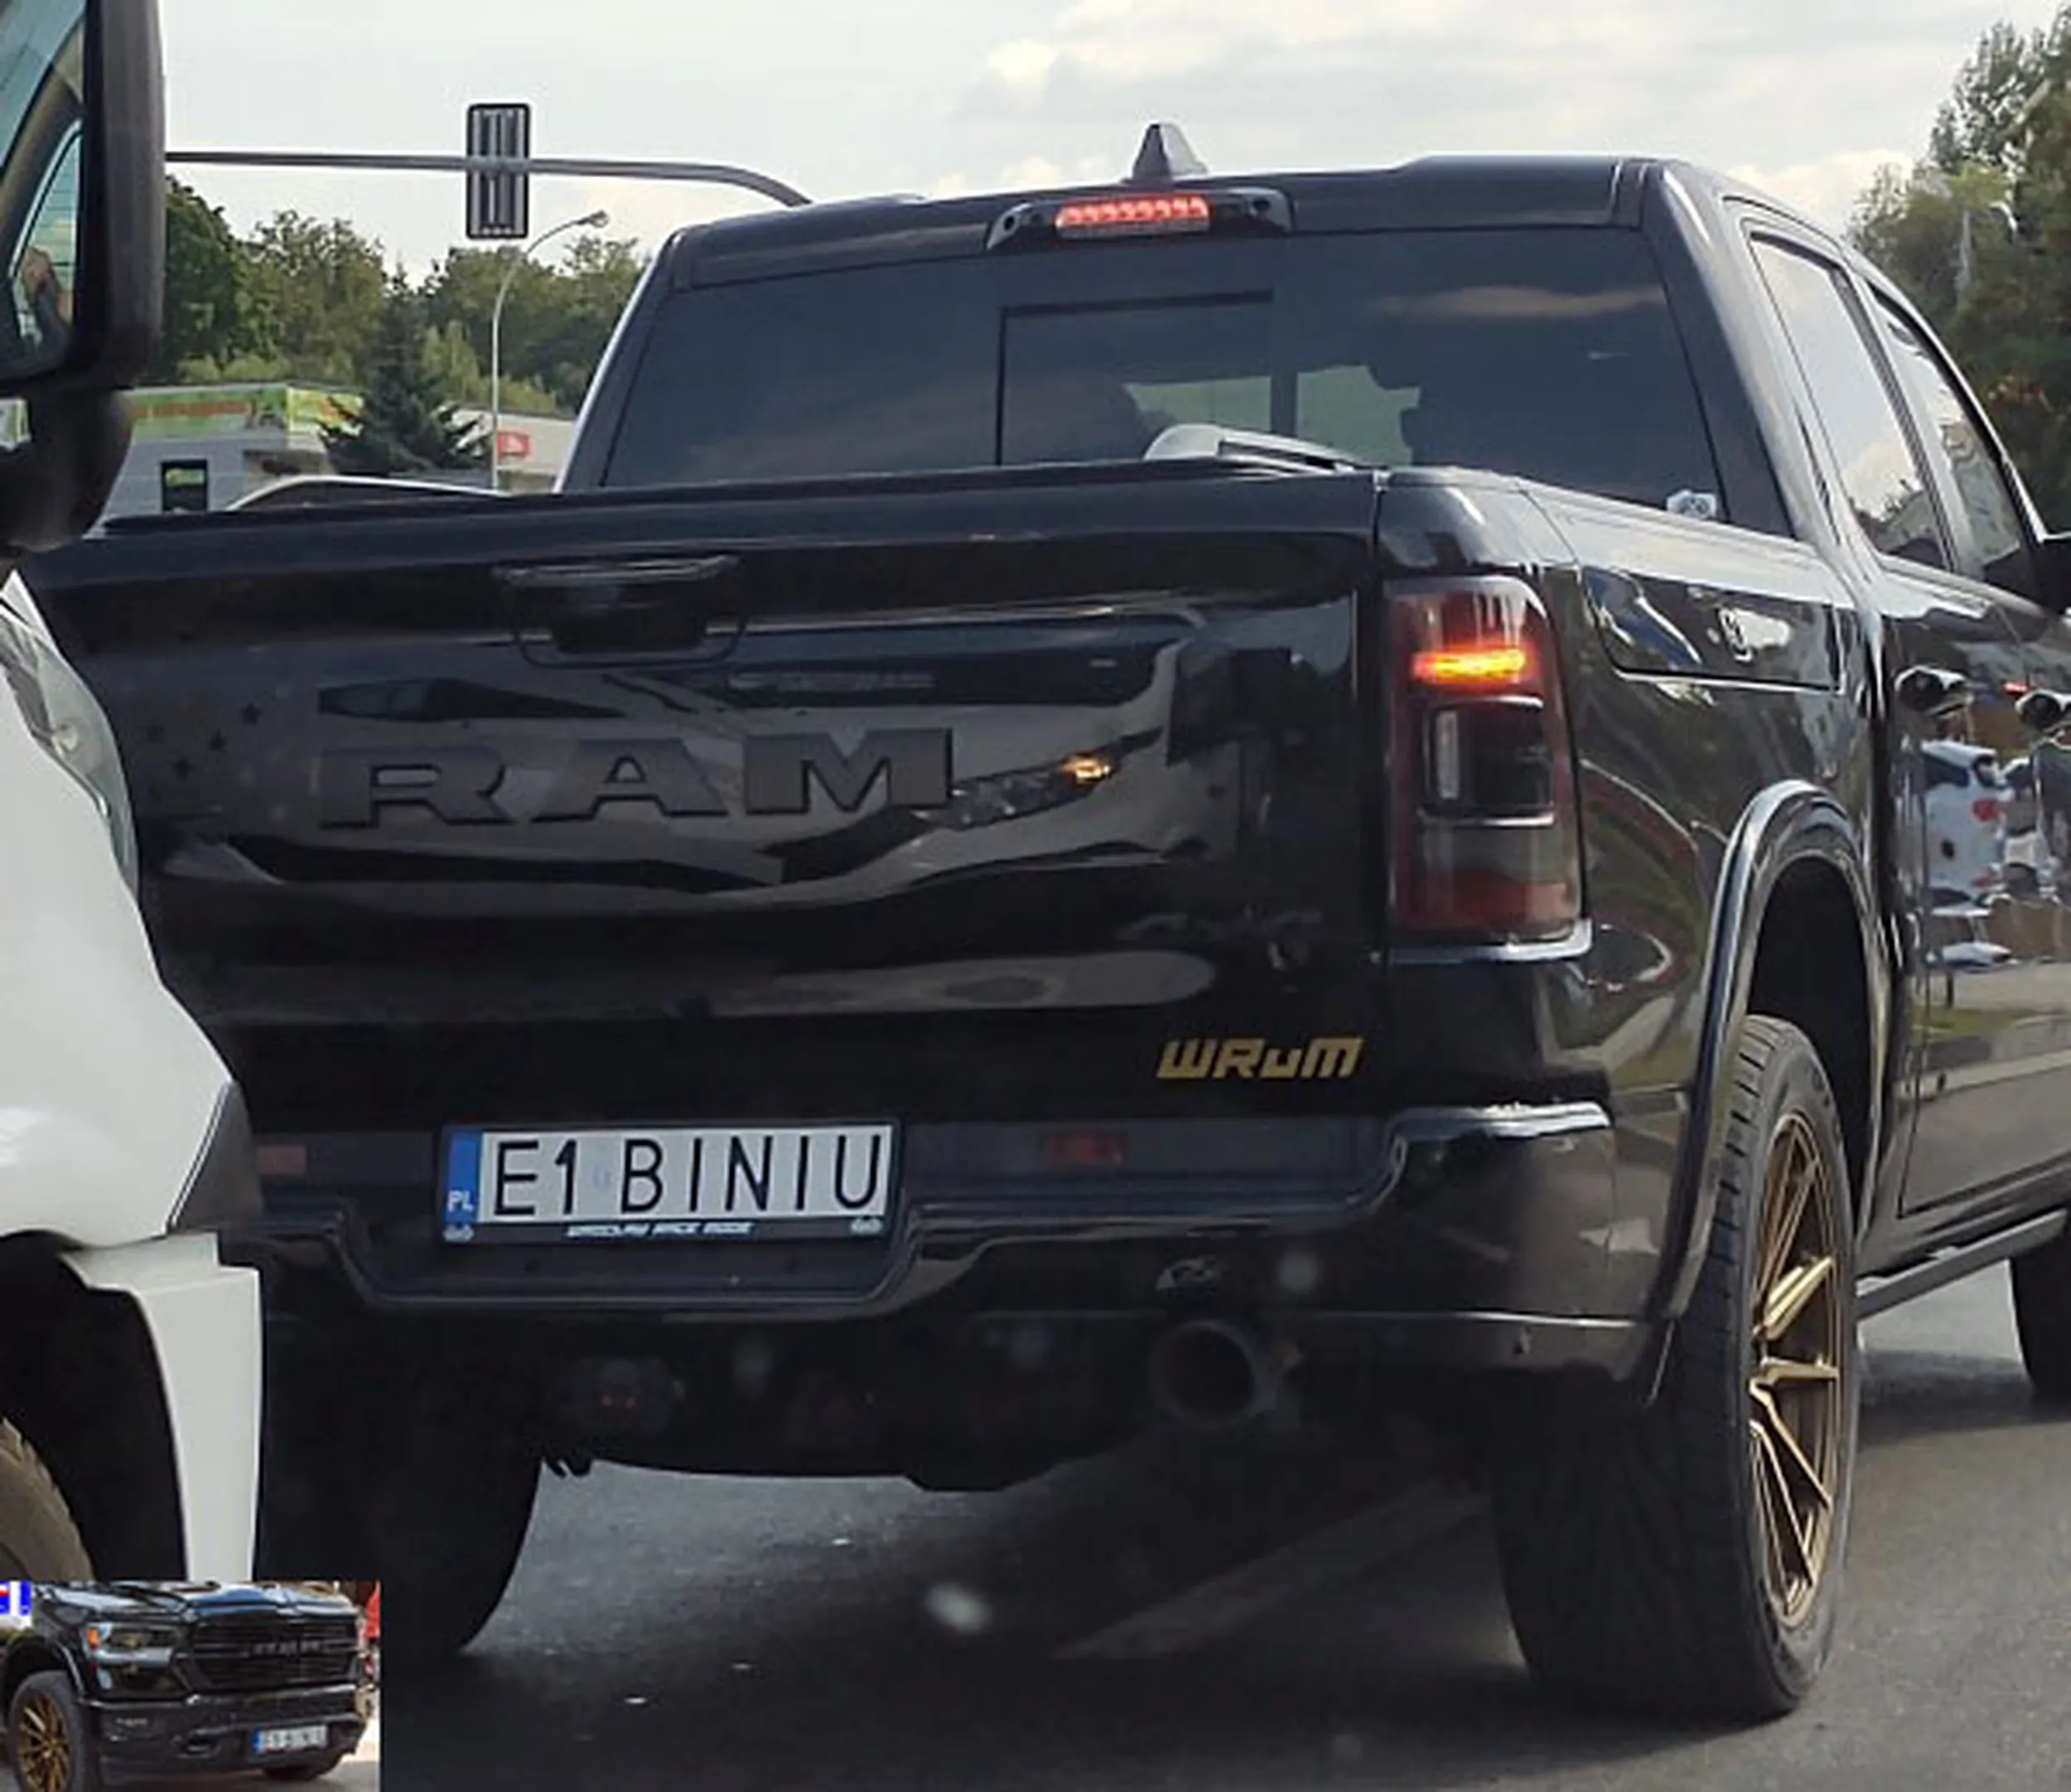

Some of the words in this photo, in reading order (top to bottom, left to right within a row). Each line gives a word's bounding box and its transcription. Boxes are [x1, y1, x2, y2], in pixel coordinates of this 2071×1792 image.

[320, 727, 954, 829] RAM
[447, 1191, 474, 1212] PL
[494, 1138, 578, 1216] E1
[620, 1135, 881, 1215] BINIU
